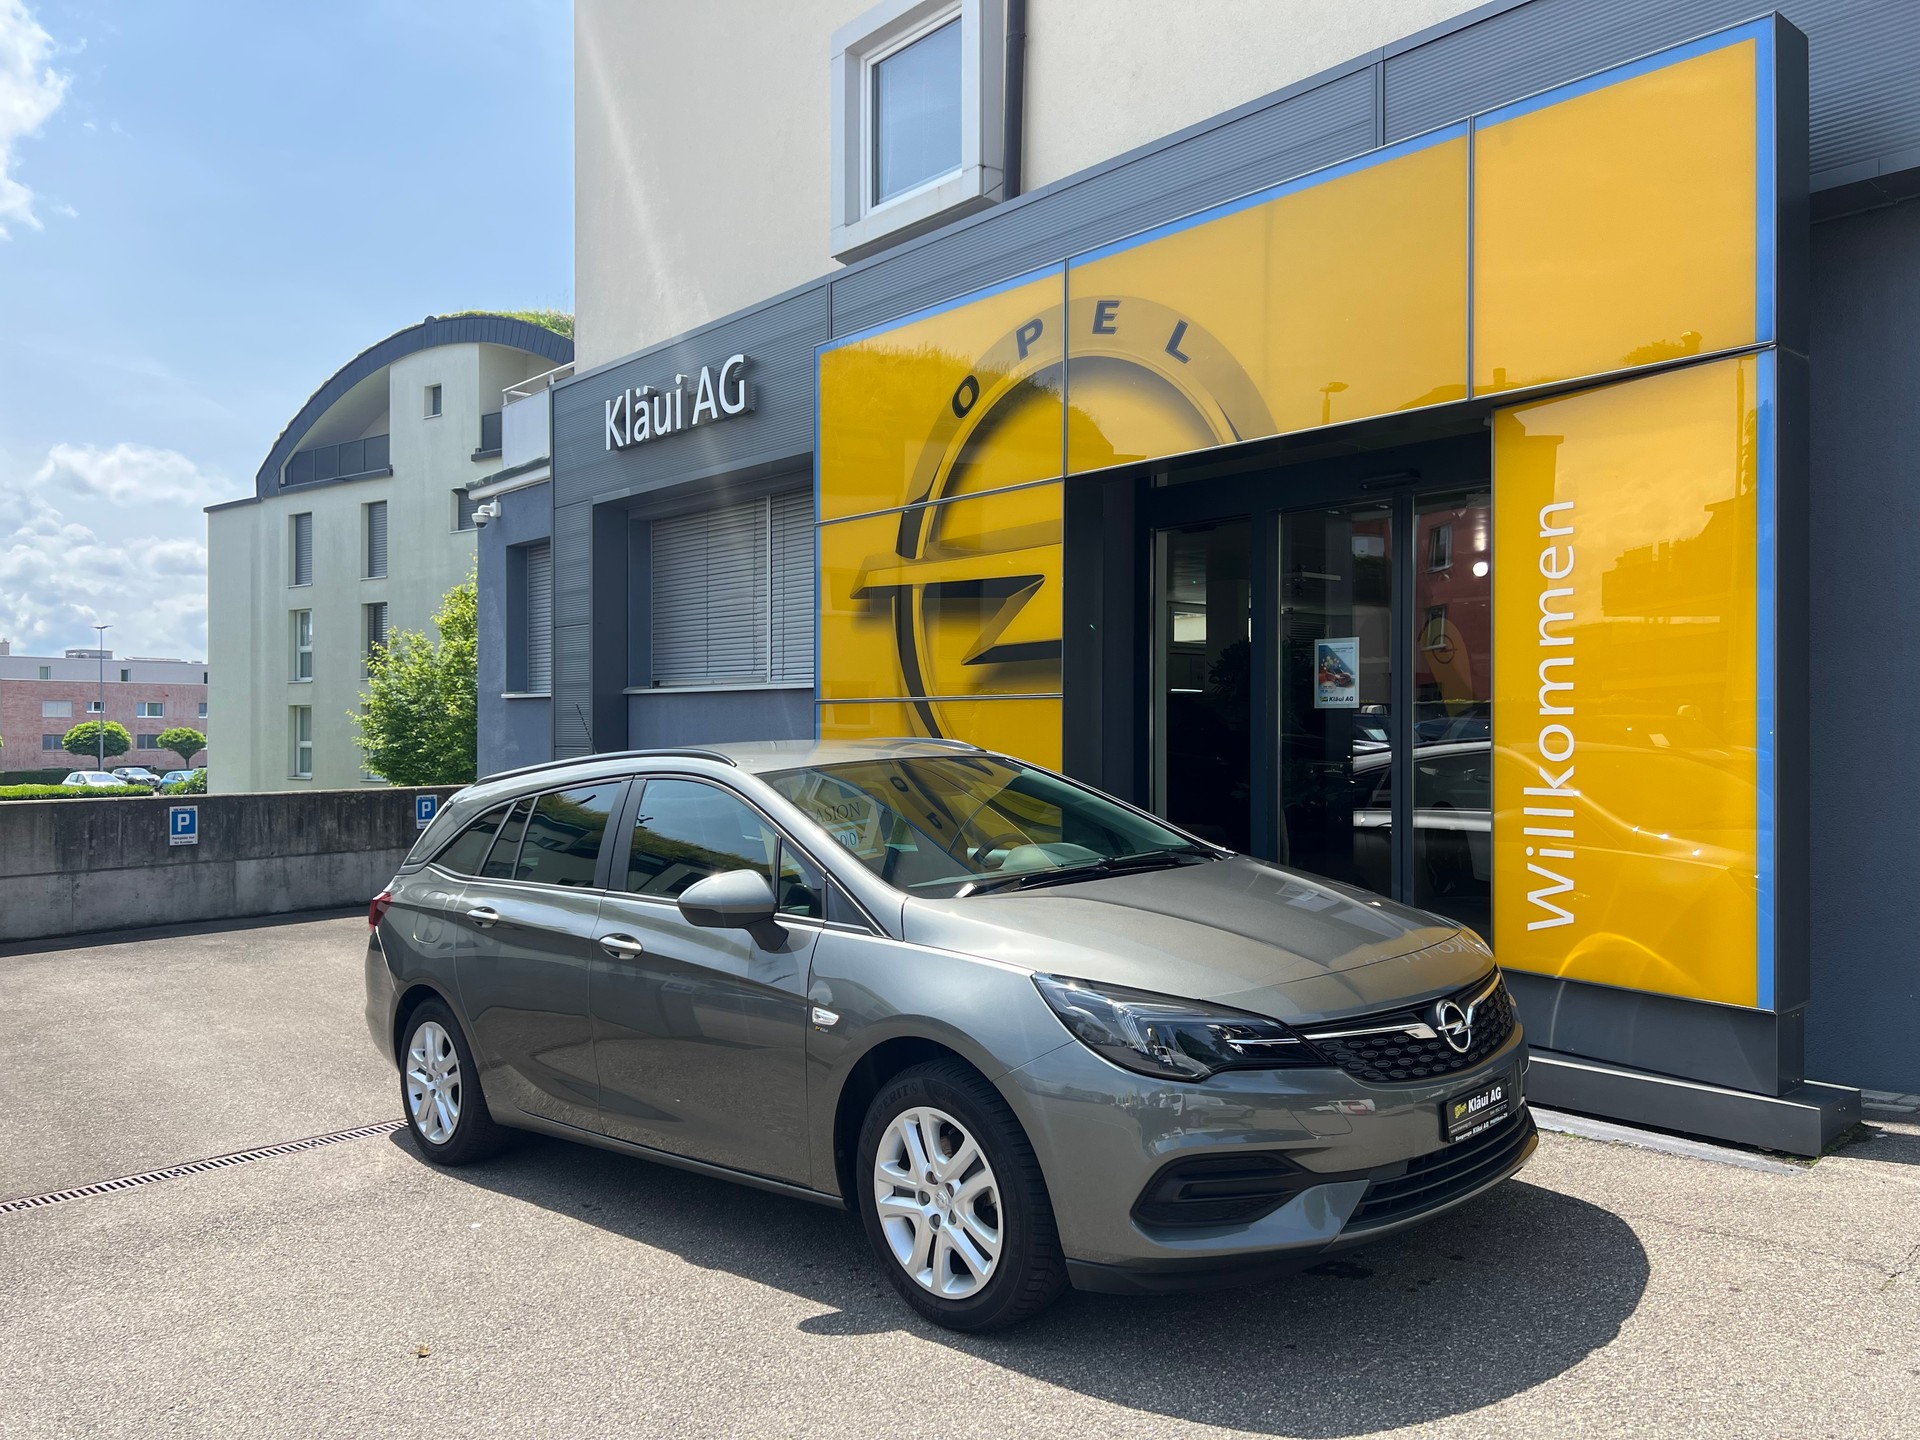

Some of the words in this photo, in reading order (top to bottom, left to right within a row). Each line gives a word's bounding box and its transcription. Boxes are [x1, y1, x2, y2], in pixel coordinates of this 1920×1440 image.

[952, 300, 1192, 419] OPEL
[605, 373, 684, 451] Kläui
[691, 353, 748, 426] AG
[1523, 500, 1575, 931] Willkommen
[177, 813, 190, 832] P
[421, 801, 432, 818] P
[1468, 1092, 1489, 1113] Kläui
[1490, 1086, 1502, 1103] AG
